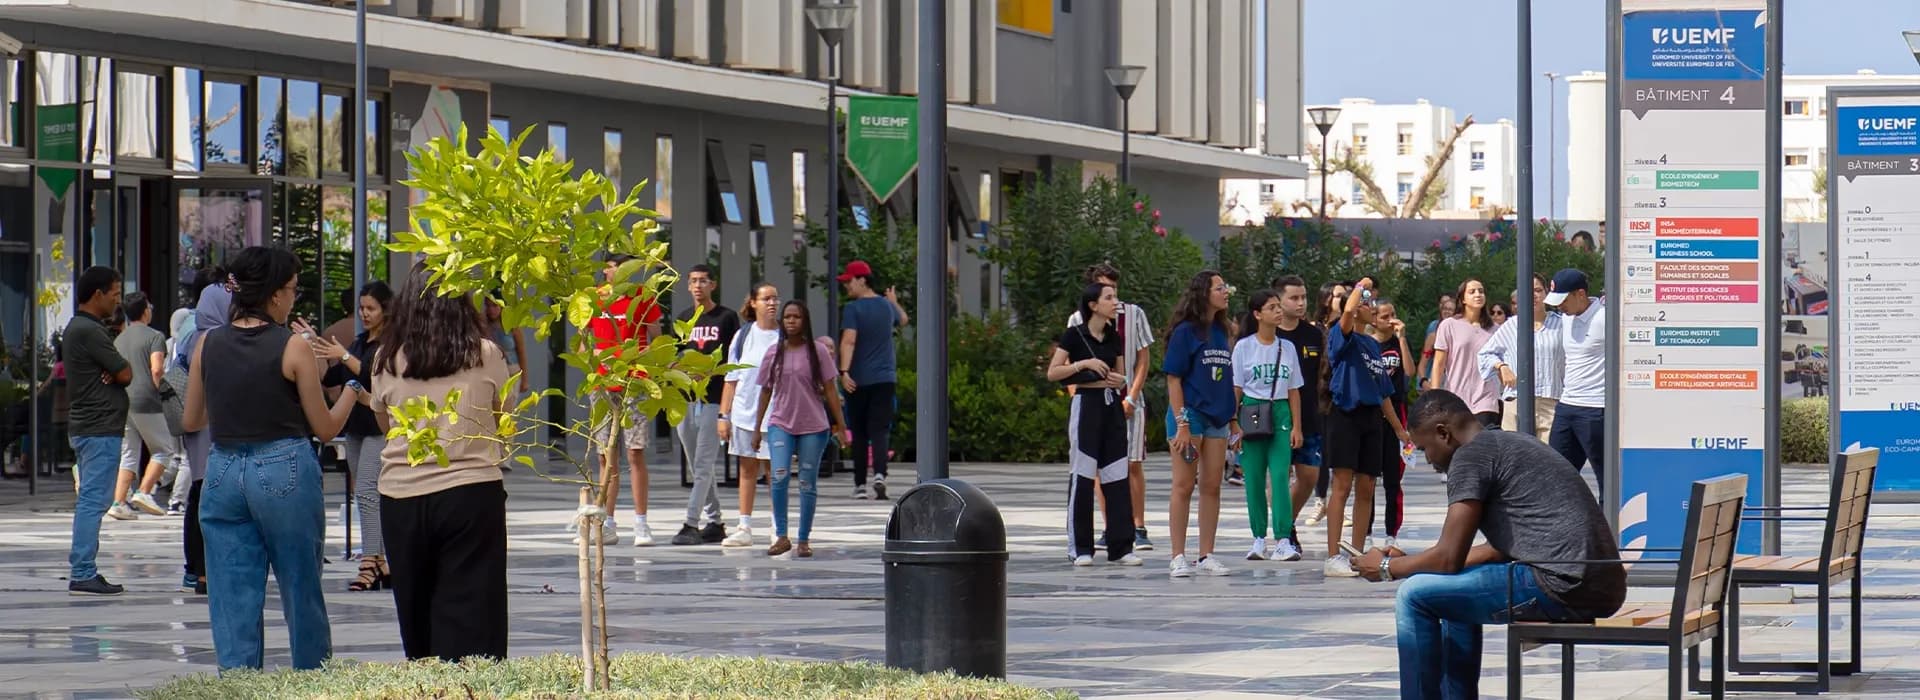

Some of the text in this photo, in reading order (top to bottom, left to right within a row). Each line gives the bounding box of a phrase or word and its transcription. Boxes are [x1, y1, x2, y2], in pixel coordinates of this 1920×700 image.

[1672, 28, 1736, 44] UEMF
[1636, 86, 1736, 105] BÂTIMENT 4
[872, 116, 909, 127] UEMF
[1871, 118, 1917, 130] UEMF
[1659, 154, 1667, 165] 4
[1847, 158, 1919, 171] BÂTIMENT 3
[1660, 197, 1667, 208] 3
[1865, 206, 1871, 214] 0
[1629, 221, 1651, 230] INSA
[1865, 251, 1869, 260] 1
[1865, 273, 1871, 281] 4
[1658, 310, 1666, 321] 2
[687, 325, 720, 341] ULLS
[1203, 349, 1231, 357] EUROMED
[1202, 357, 1232, 366] UNIVERSITY
[1658, 354, 1663, 365] 1
[1705, 437, 1748, 449] UEMF
